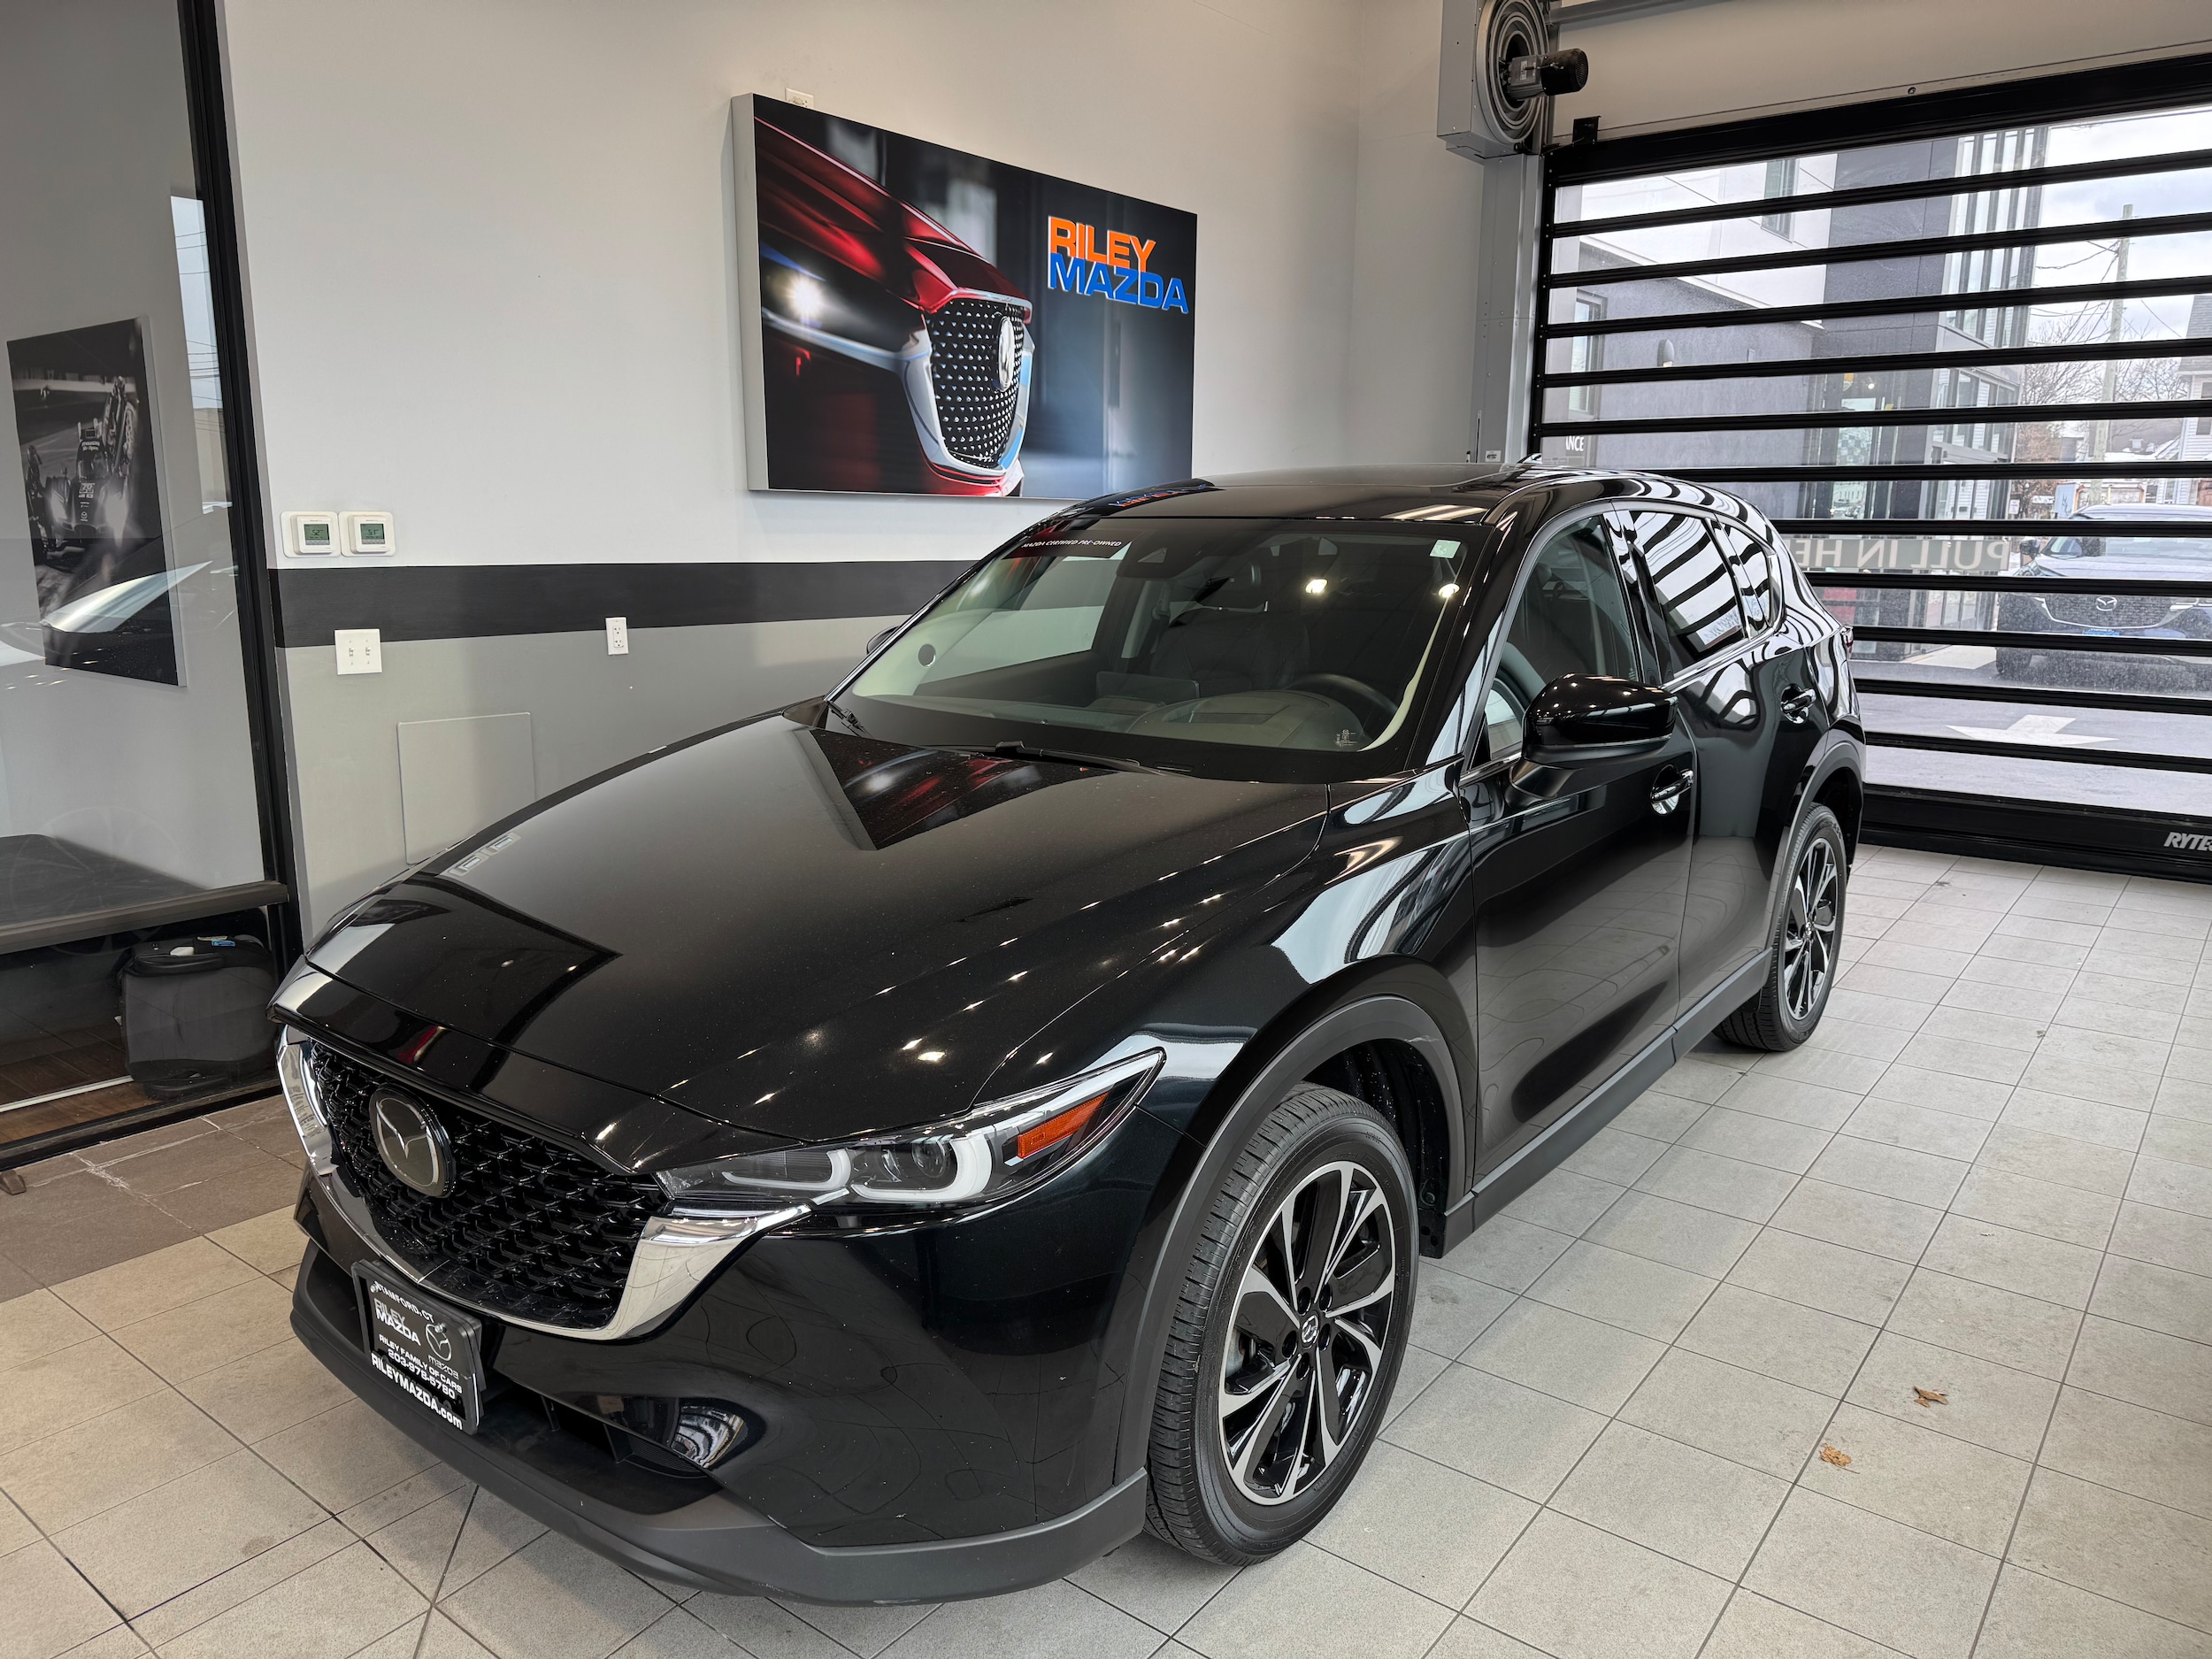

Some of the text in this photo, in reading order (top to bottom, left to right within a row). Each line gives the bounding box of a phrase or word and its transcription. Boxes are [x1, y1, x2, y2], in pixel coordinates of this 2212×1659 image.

[1048, 215, 1156, 273] RILEY
[1048, 251, 1189, 314] MAZDA
[2163, 832, 2212, 851] RYTE
[374, 1297, 405, 1326] RILEY
[376, 1308, 421, 1346] MAZDA
[372, 1353, 463, 1431] RILEYMAZDA.com
[379, 1333, 463, 1394] RILEY FAMILY OF CARS
